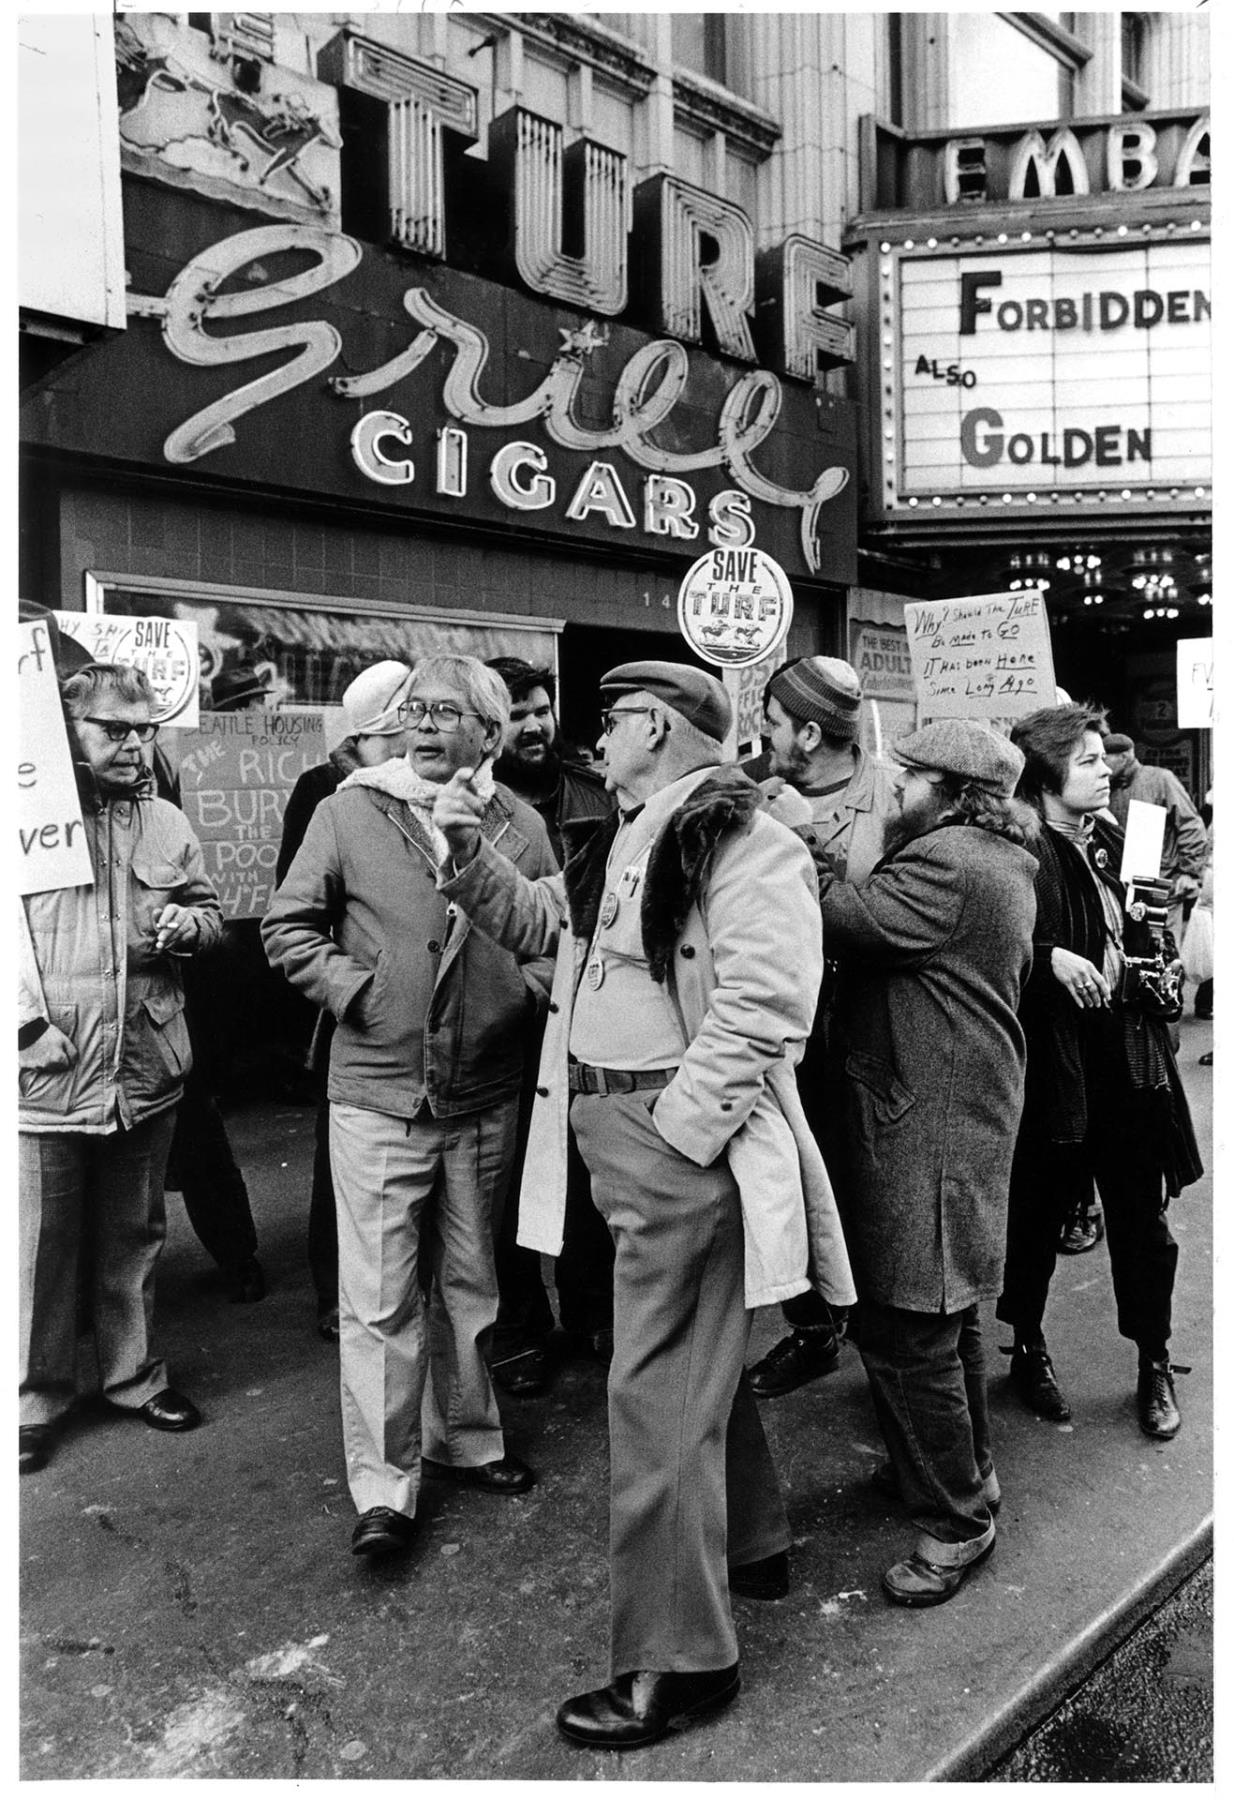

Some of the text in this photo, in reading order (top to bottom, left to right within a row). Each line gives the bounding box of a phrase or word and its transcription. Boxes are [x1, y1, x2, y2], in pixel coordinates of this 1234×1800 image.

[342, 30, 858, 386] TURF
[959, 270, 1210, 336] FORBIDDEN
[915, 353, 977, 389] ALSO
[960, 406, 1152, 469] GOLDEN
[350, 409, 757, 549] CIGARS
[712, 549, 758, 583] SAVE
[706, 582, 763, 595] THE
[689, 590, 777, 622] TURF
[135, 621, 171, 649] SAVE
[860, 652, 912, 675] ADULT
[251, 734, 300, 748] POLICY
[264, 715, 323, 736] HOUSING
[197, 789, 291, 827] BUR
[233, 824, 273, 842] THE
[216, 841, 280, 871] POO
